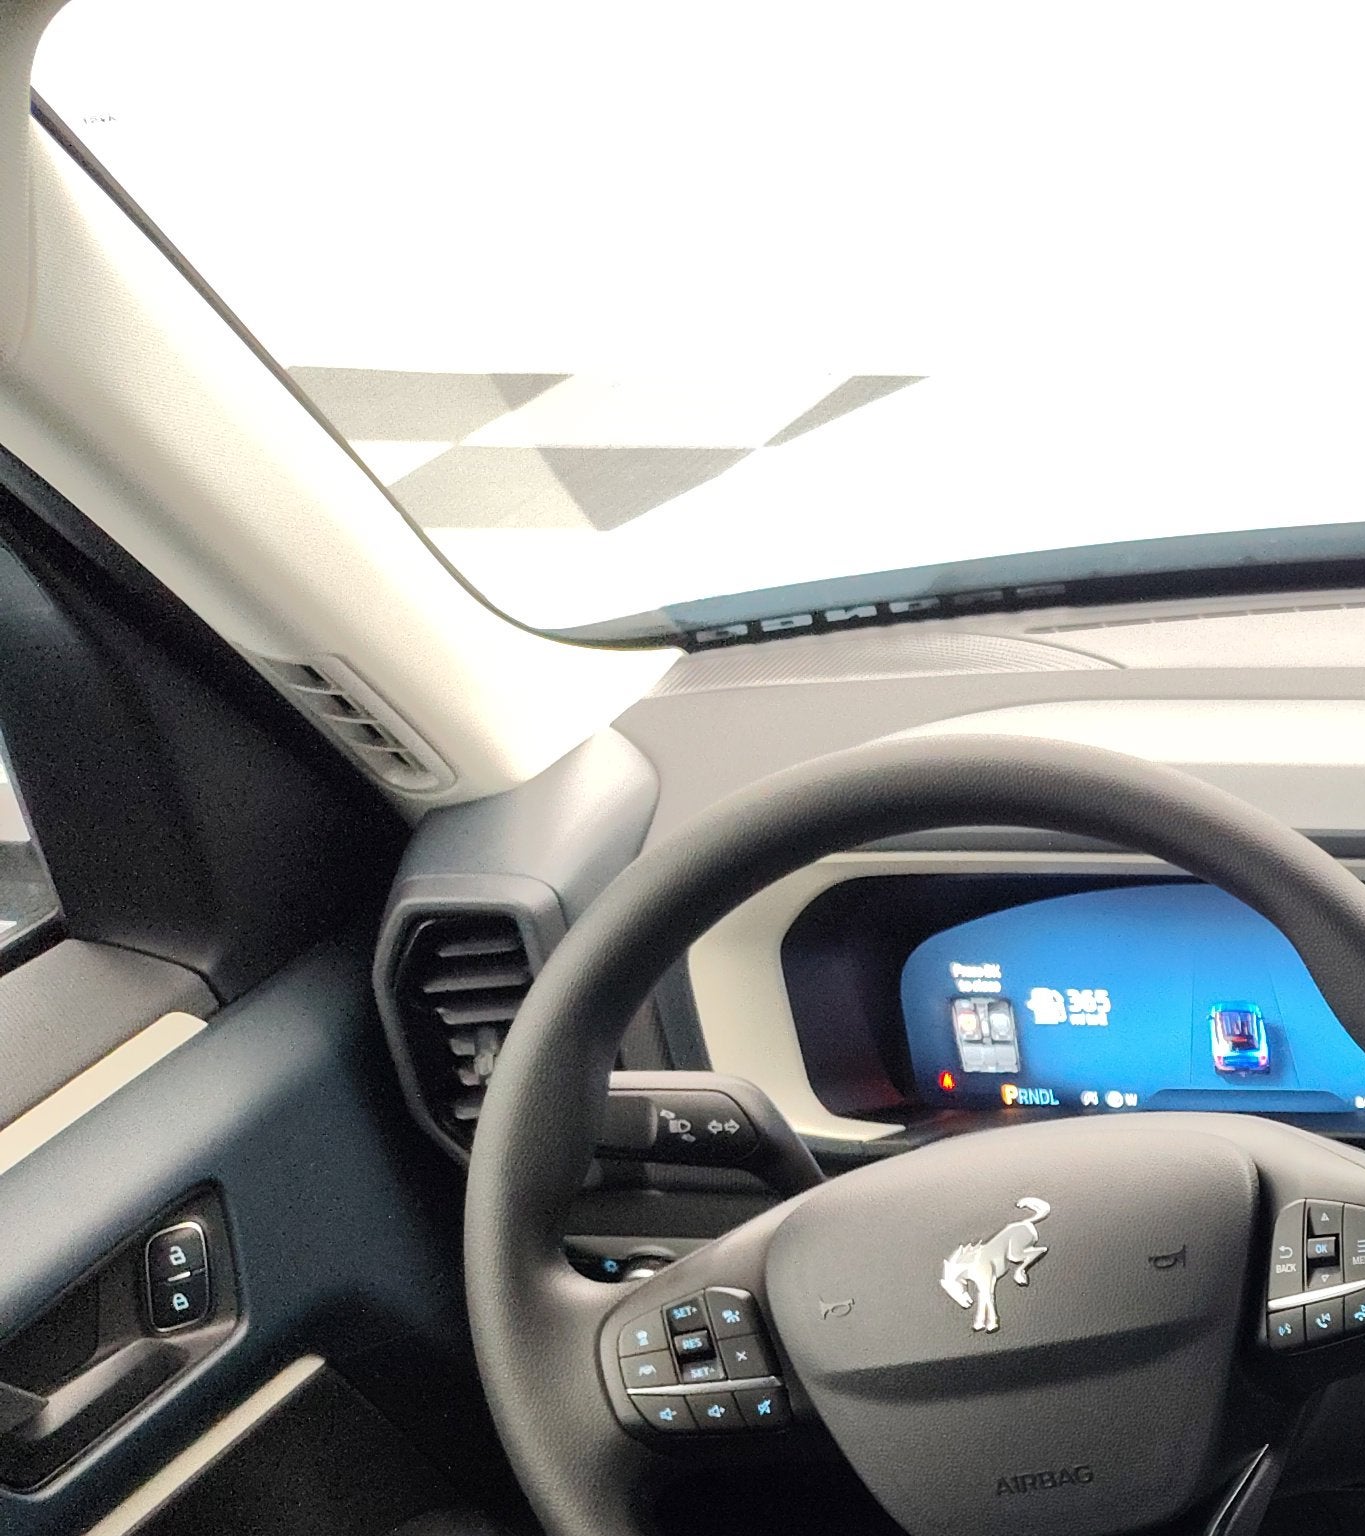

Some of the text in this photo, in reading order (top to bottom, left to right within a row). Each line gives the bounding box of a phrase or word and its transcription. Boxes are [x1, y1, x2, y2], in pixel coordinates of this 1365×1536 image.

[1315, 1244, 1328, 1254] OK
[1276, 1264, 1297, 1274] BACK
[998, 1466, 1093, 1495] AIRBAG
